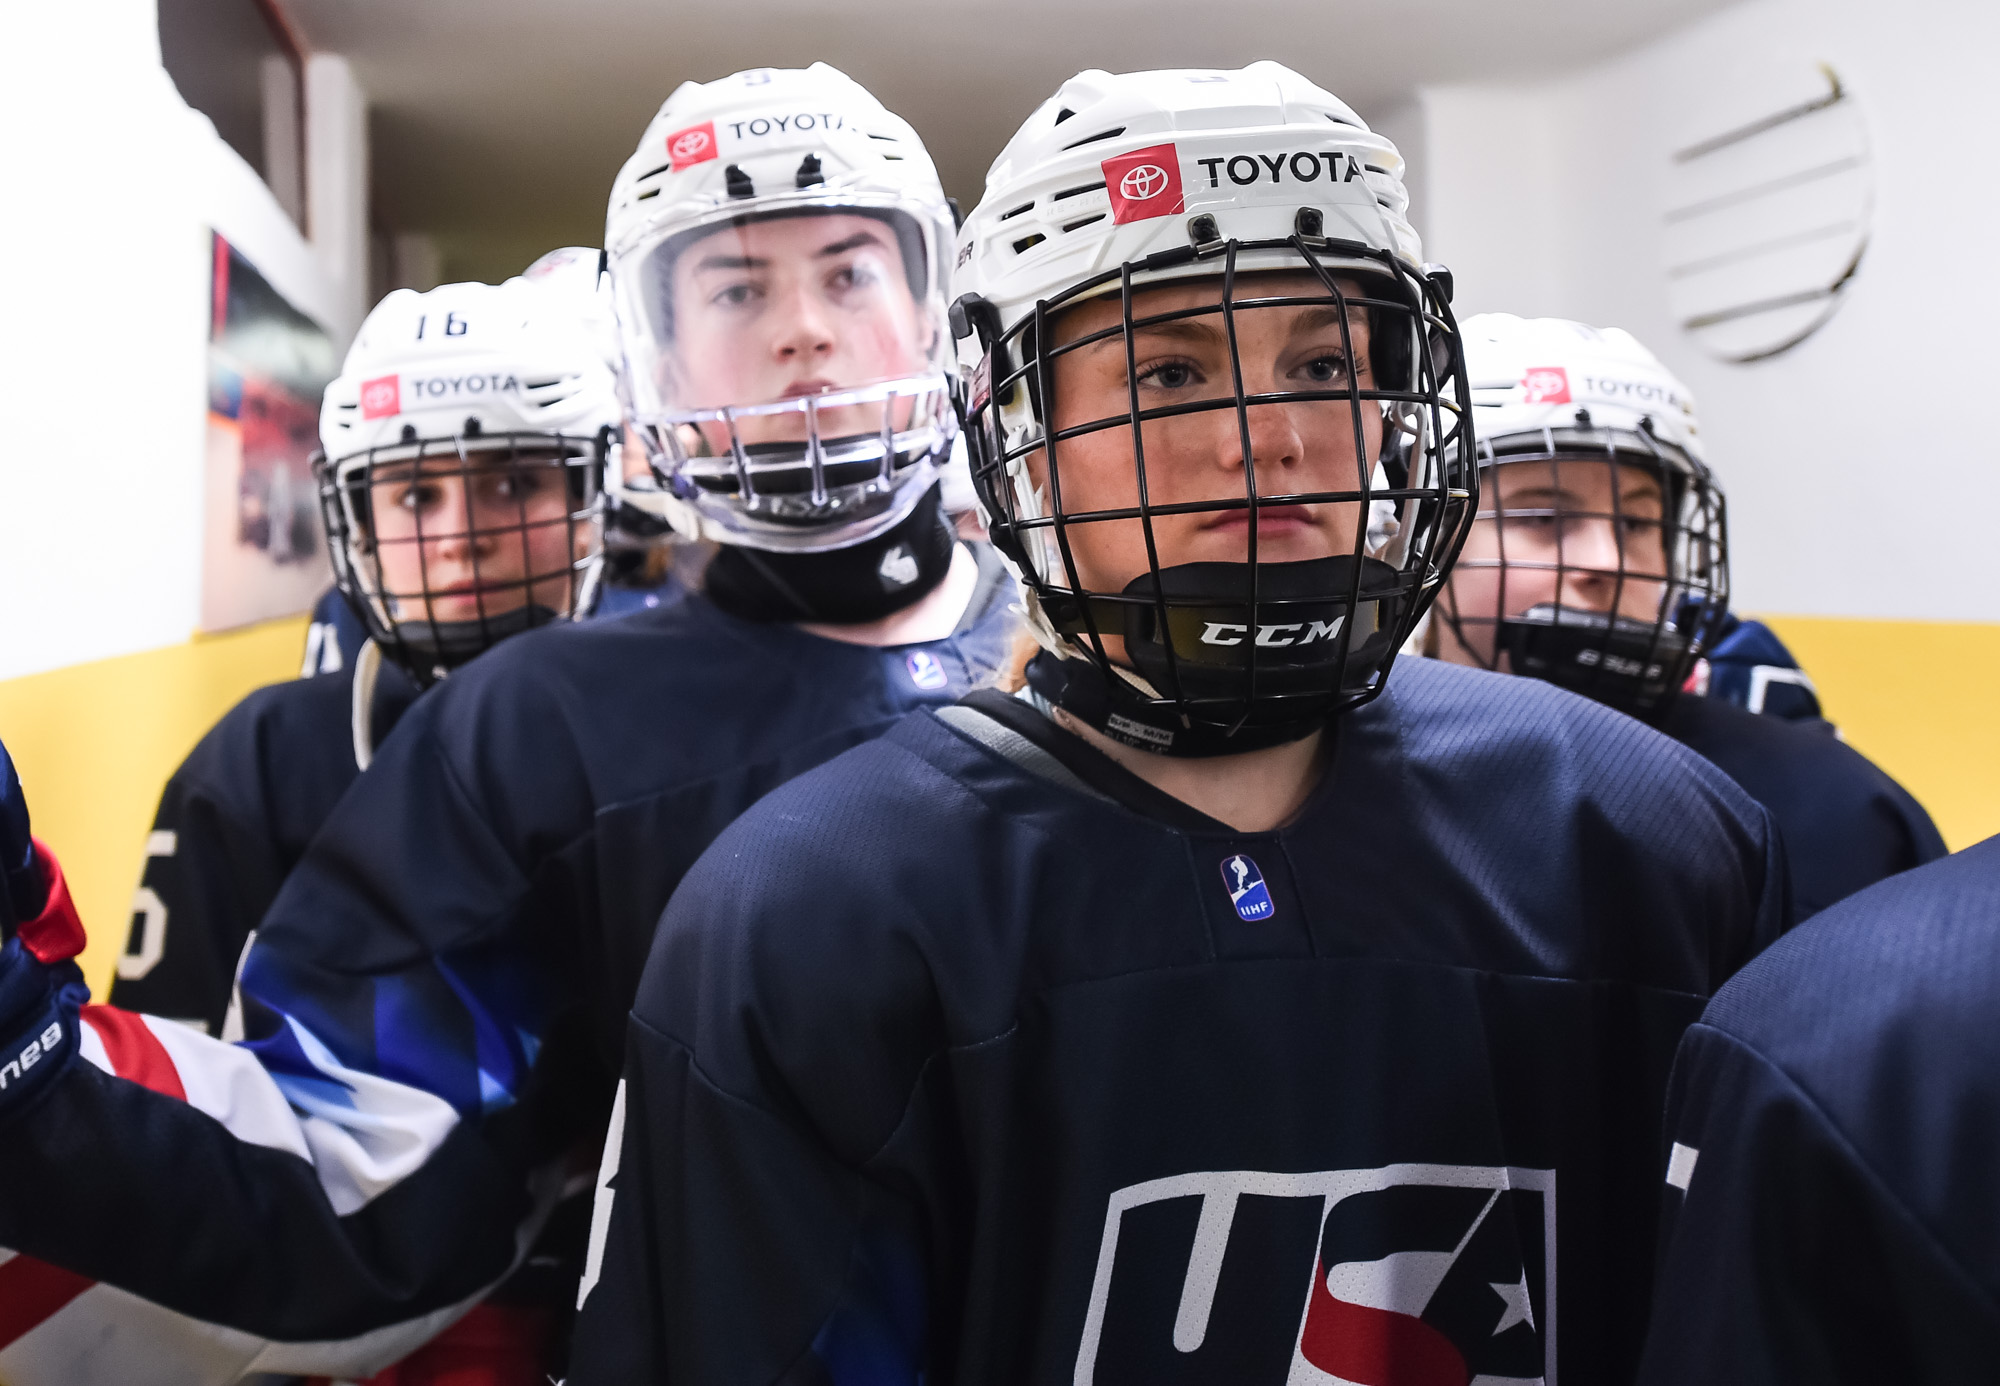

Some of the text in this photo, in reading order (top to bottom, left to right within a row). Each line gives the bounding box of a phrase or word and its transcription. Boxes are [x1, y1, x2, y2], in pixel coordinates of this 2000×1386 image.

[1198, 151, 1364, 188] TOYOTA
[417, 312, 468, 340] 16
[413, 375, 519, 398] TOYOTA
[1200, 615, 1346, 647] CCM
[1240, 901, 1268, 916] IIHF
[1074, 1163, 1557, 1386] USA
